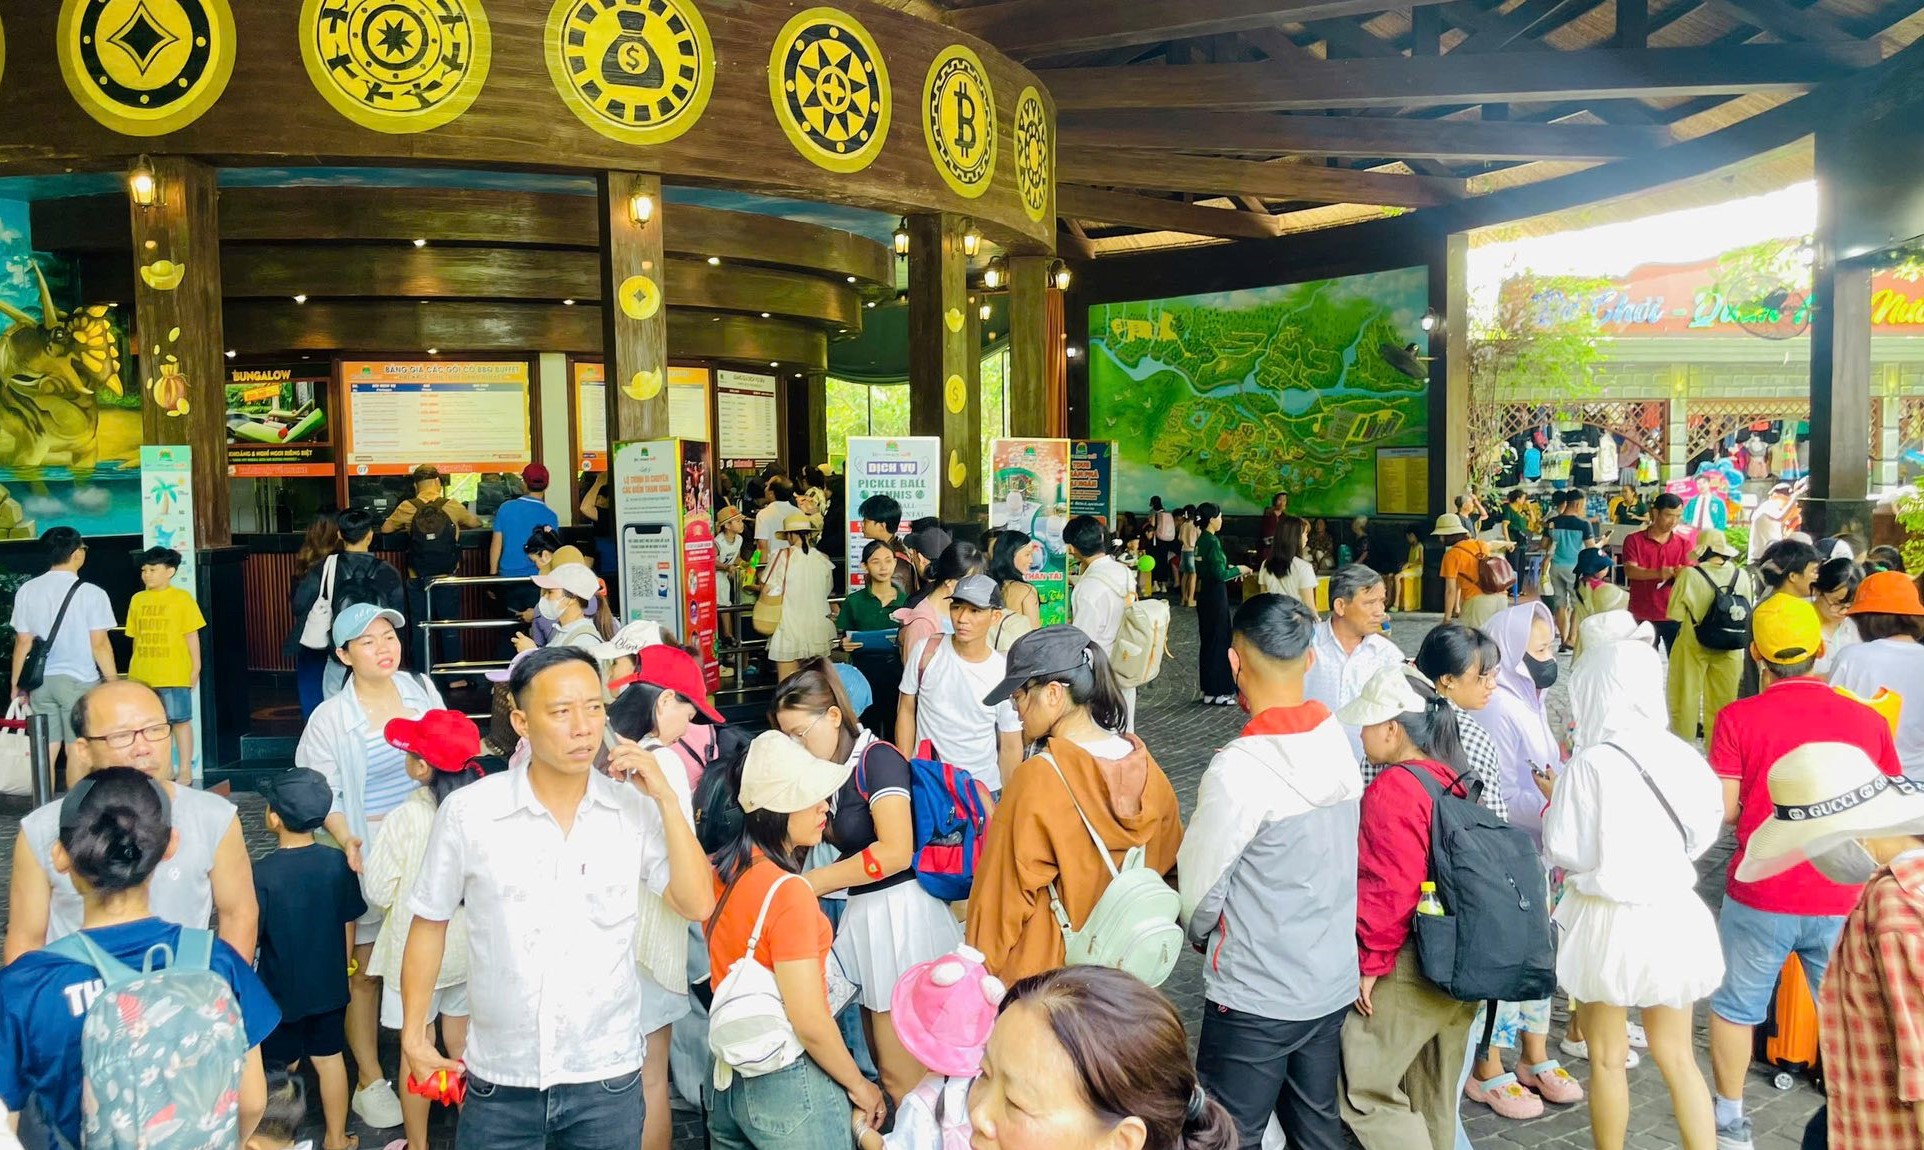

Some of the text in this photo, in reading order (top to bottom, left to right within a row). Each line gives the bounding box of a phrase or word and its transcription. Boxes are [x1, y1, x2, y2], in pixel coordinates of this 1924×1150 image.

[232, 369, 291, 382] BUNGALOW
[868, 462, 916, 475] DỊCH VỤ
[858, 479, 926, 488] PICKLE BALL
[1808, 792, 1860, 818] GUCCI
